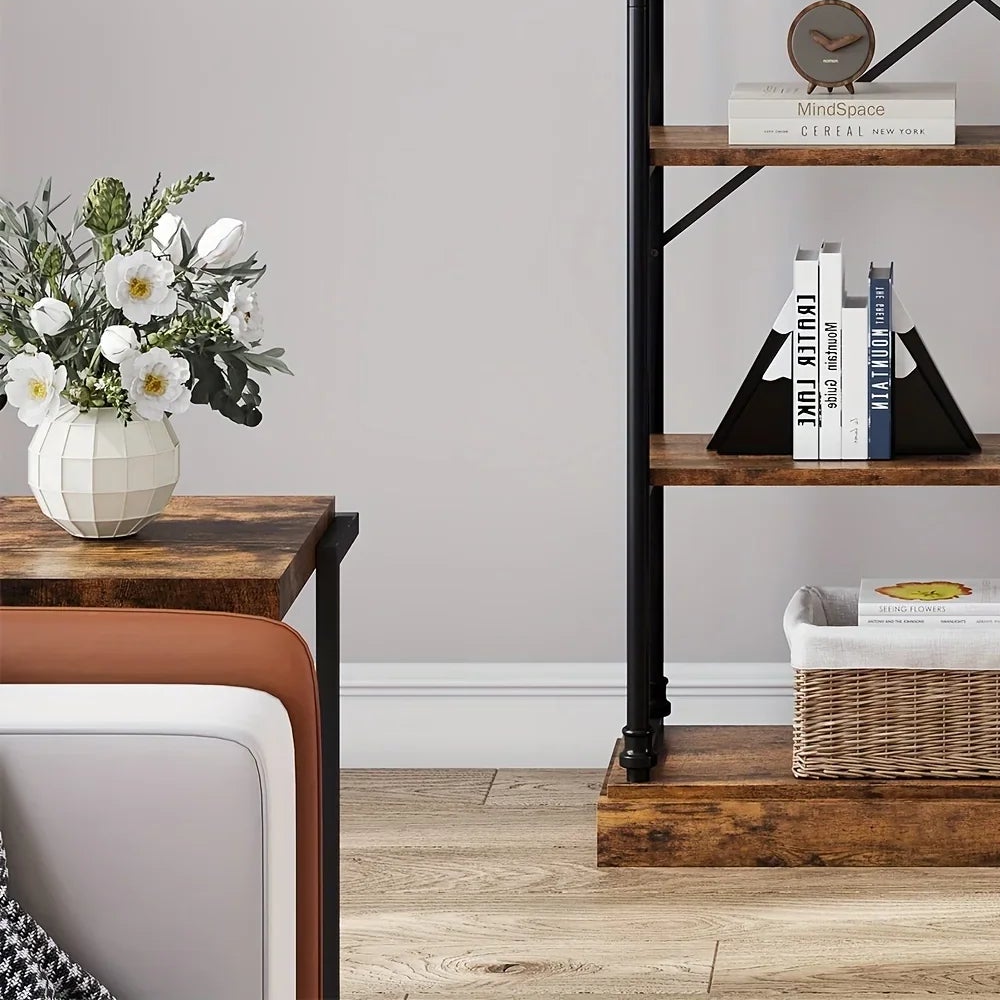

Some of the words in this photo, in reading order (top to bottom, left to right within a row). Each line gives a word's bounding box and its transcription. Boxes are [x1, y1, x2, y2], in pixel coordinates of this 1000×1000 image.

[797, 102, 886, 119] MindSpace
[801, 125, 864, 137] CEREAL
[879, 605, 908, 613] SEEING
[909, 605, 947, 613] FLOWERS
